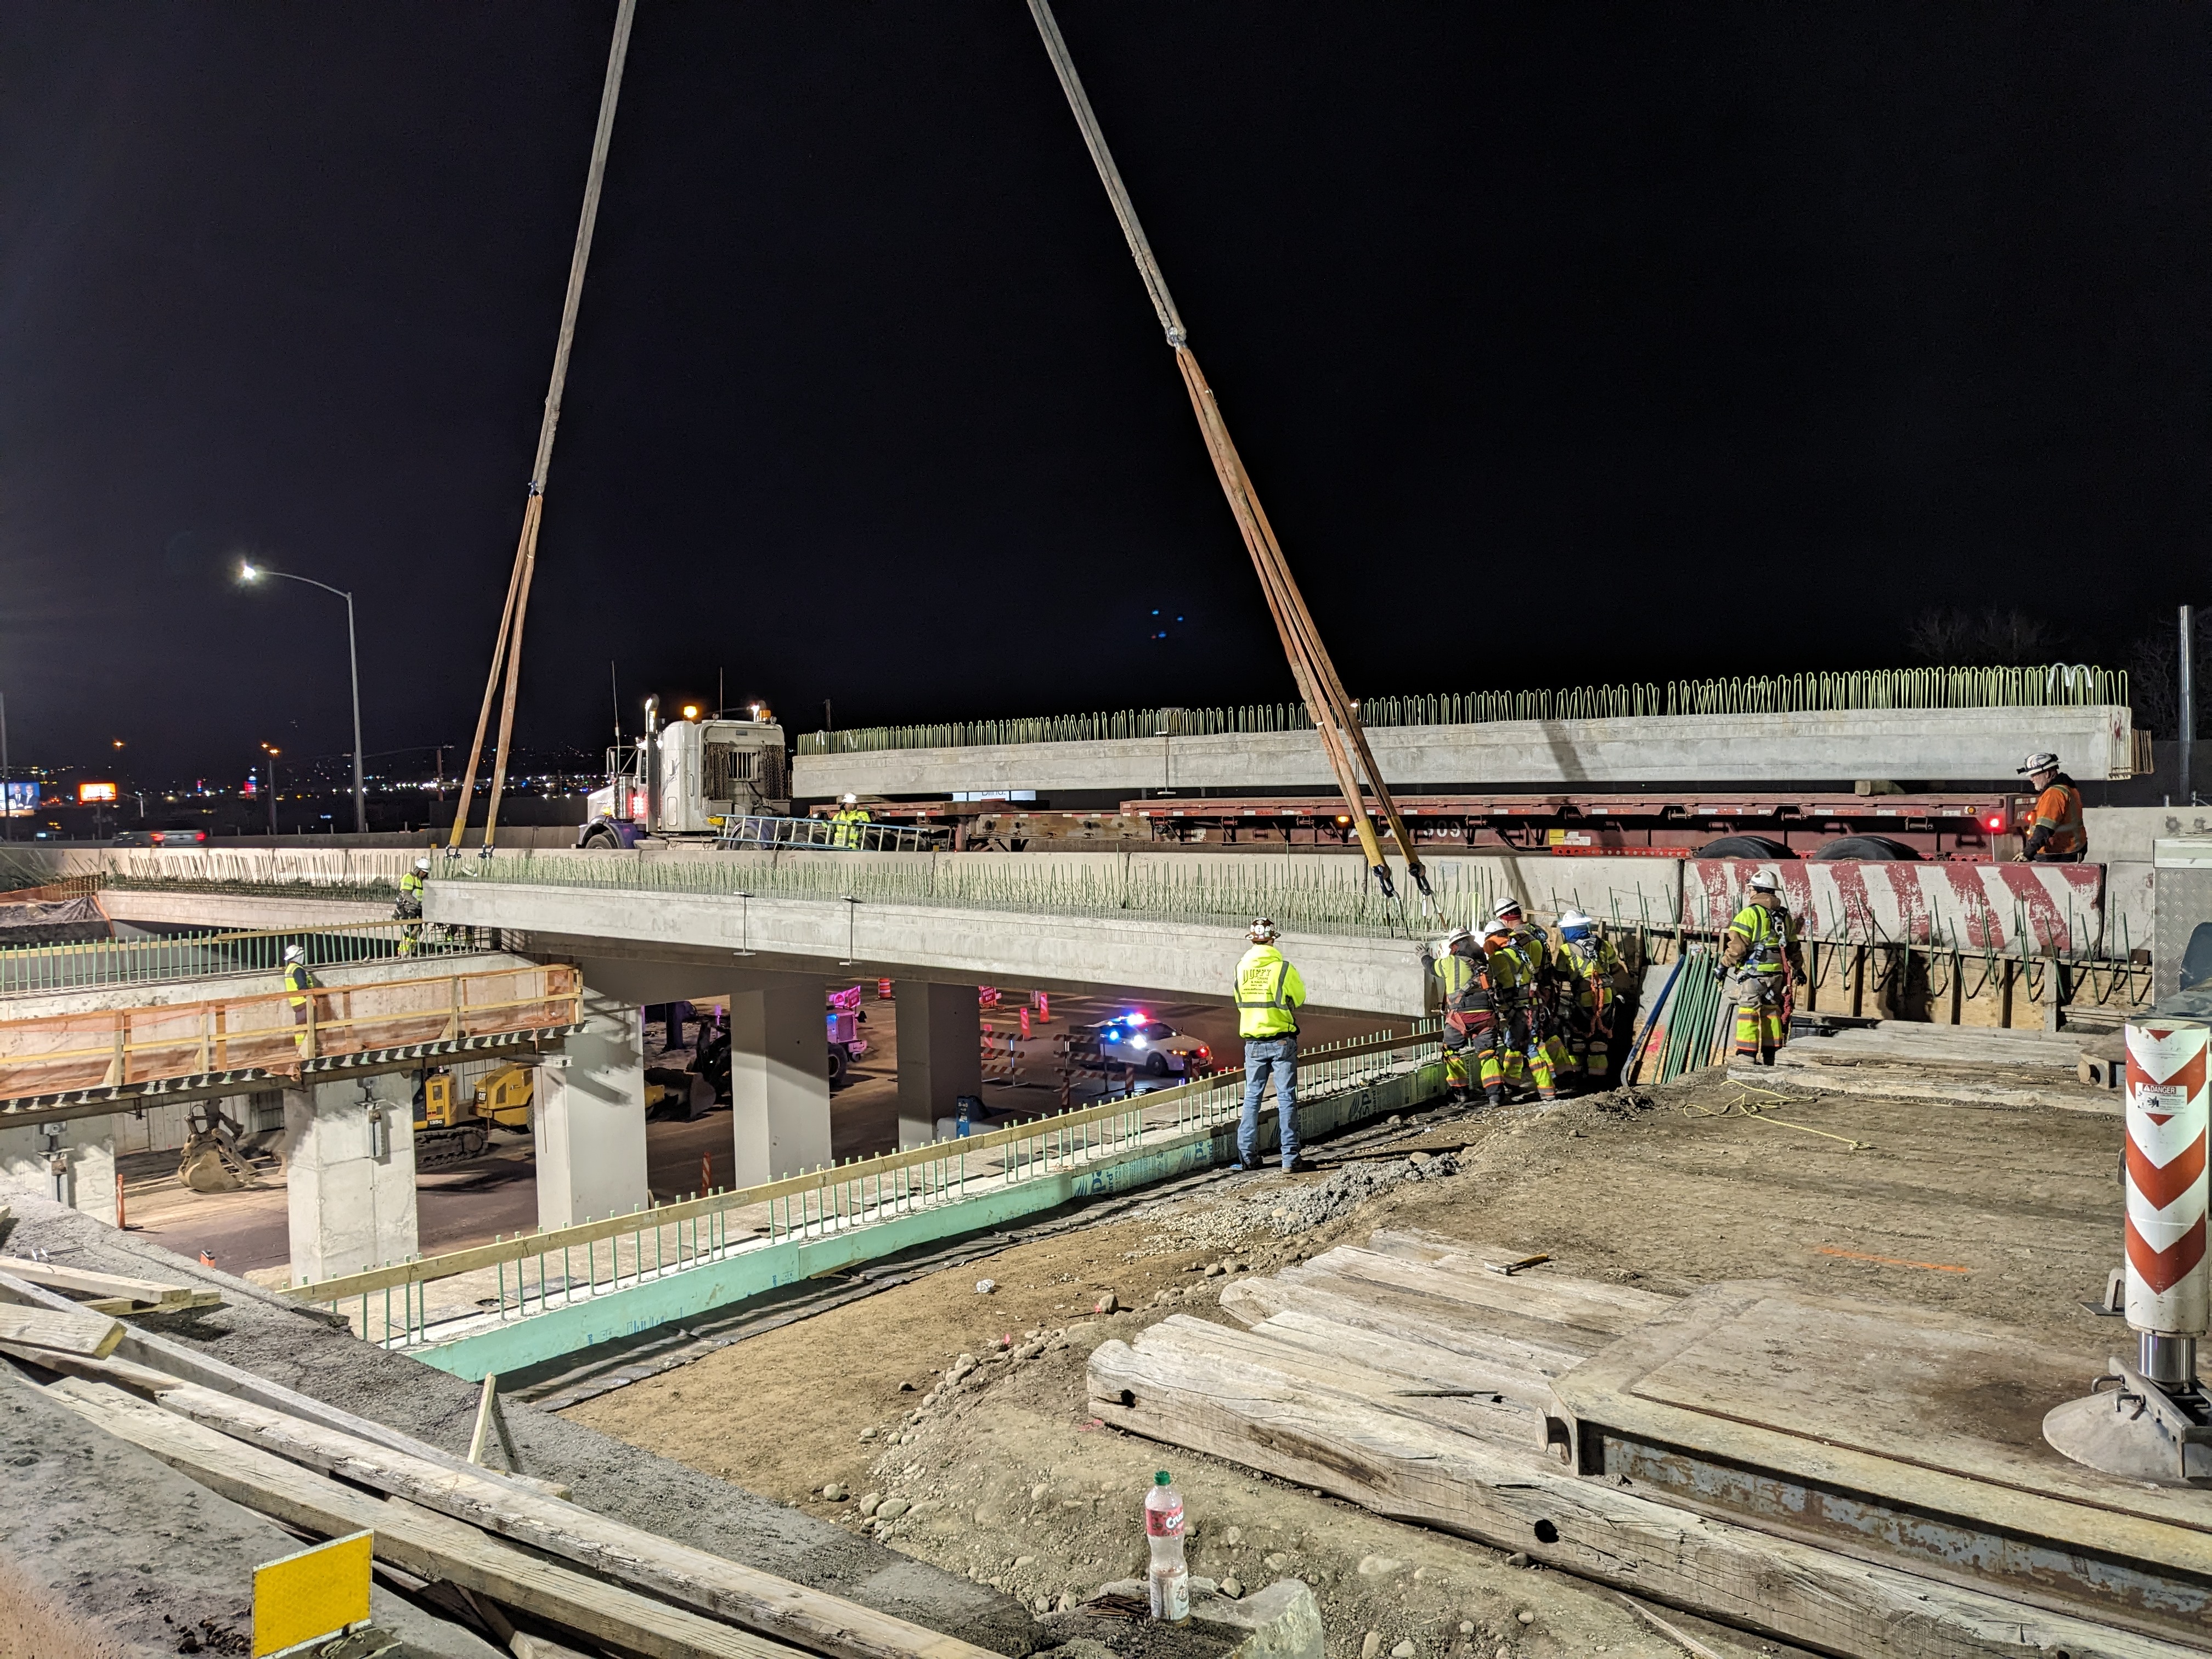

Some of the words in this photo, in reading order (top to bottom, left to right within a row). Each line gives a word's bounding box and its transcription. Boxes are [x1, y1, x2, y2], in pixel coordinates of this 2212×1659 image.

[1424, 820, 1460, 837] 309
[1242, 969, 1271, 985] DUFFY
[983, 988, 994, 996] WRONG
[2151, 1086, 2175, 1094] DANGER
[1165, 1510, 1183, 1529] Crus
